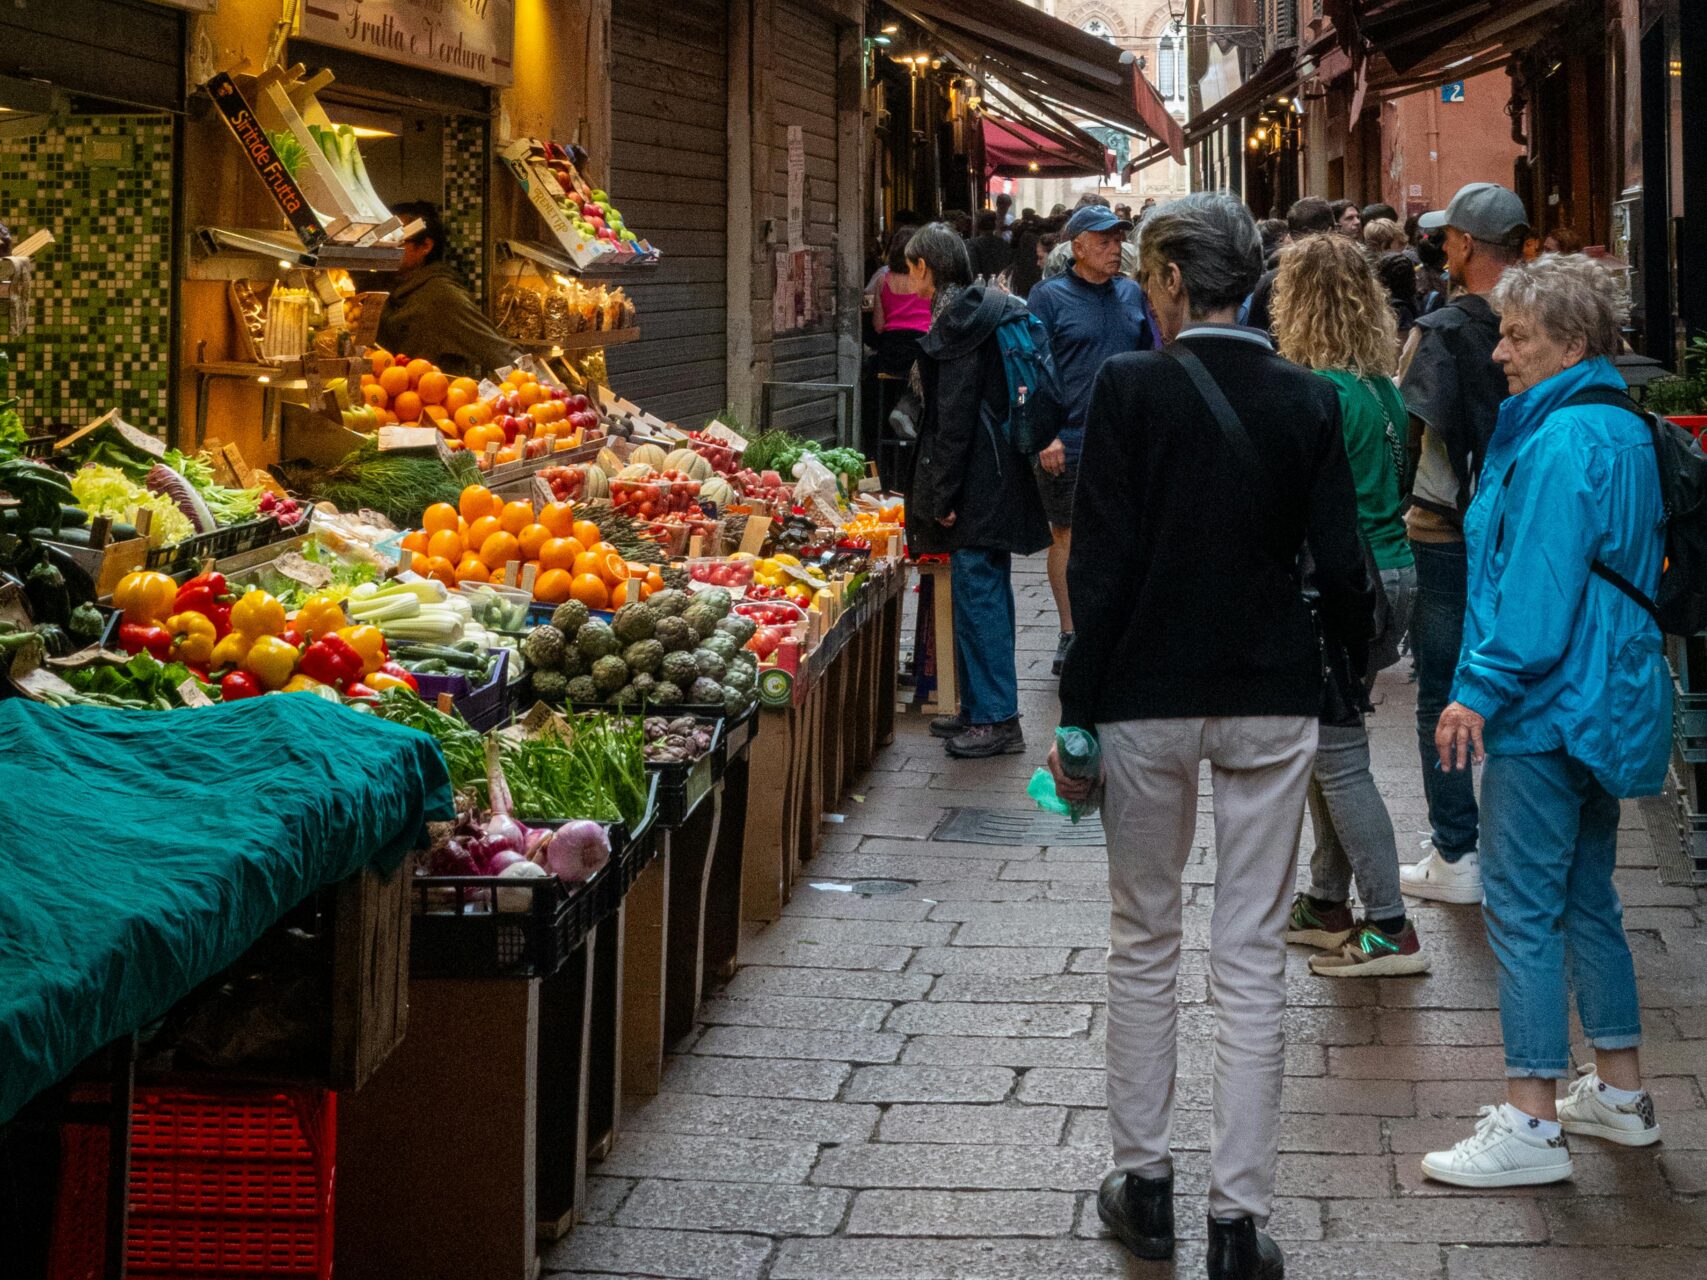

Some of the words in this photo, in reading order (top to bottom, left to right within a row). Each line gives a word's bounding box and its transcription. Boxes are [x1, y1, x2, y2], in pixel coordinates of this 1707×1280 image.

[409, 33, 418, 55] e
[422, 16, 487, 73] Verdura
[231, 109, 270, 166] Siritide
[263, 161, 301, 214] Frutta
